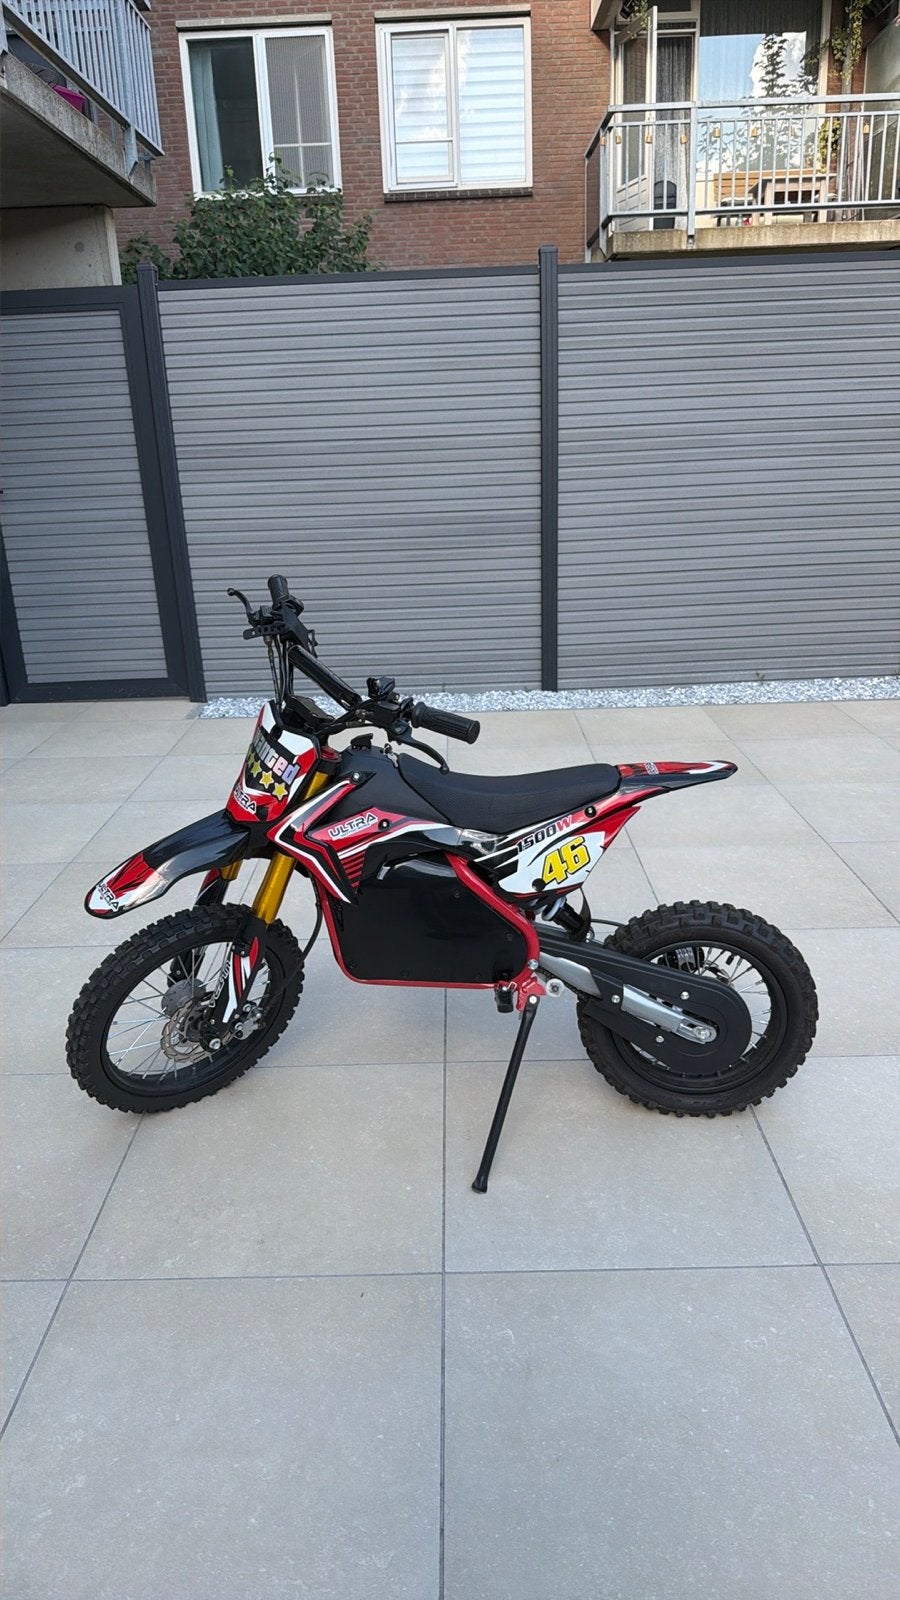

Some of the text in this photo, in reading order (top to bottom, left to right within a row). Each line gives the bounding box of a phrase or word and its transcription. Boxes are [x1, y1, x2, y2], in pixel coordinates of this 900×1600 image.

[329, 813, 377, 837] ULTRA
[516, 815, 573, 853] 1500W
[541, 835, 591, 885] 46
